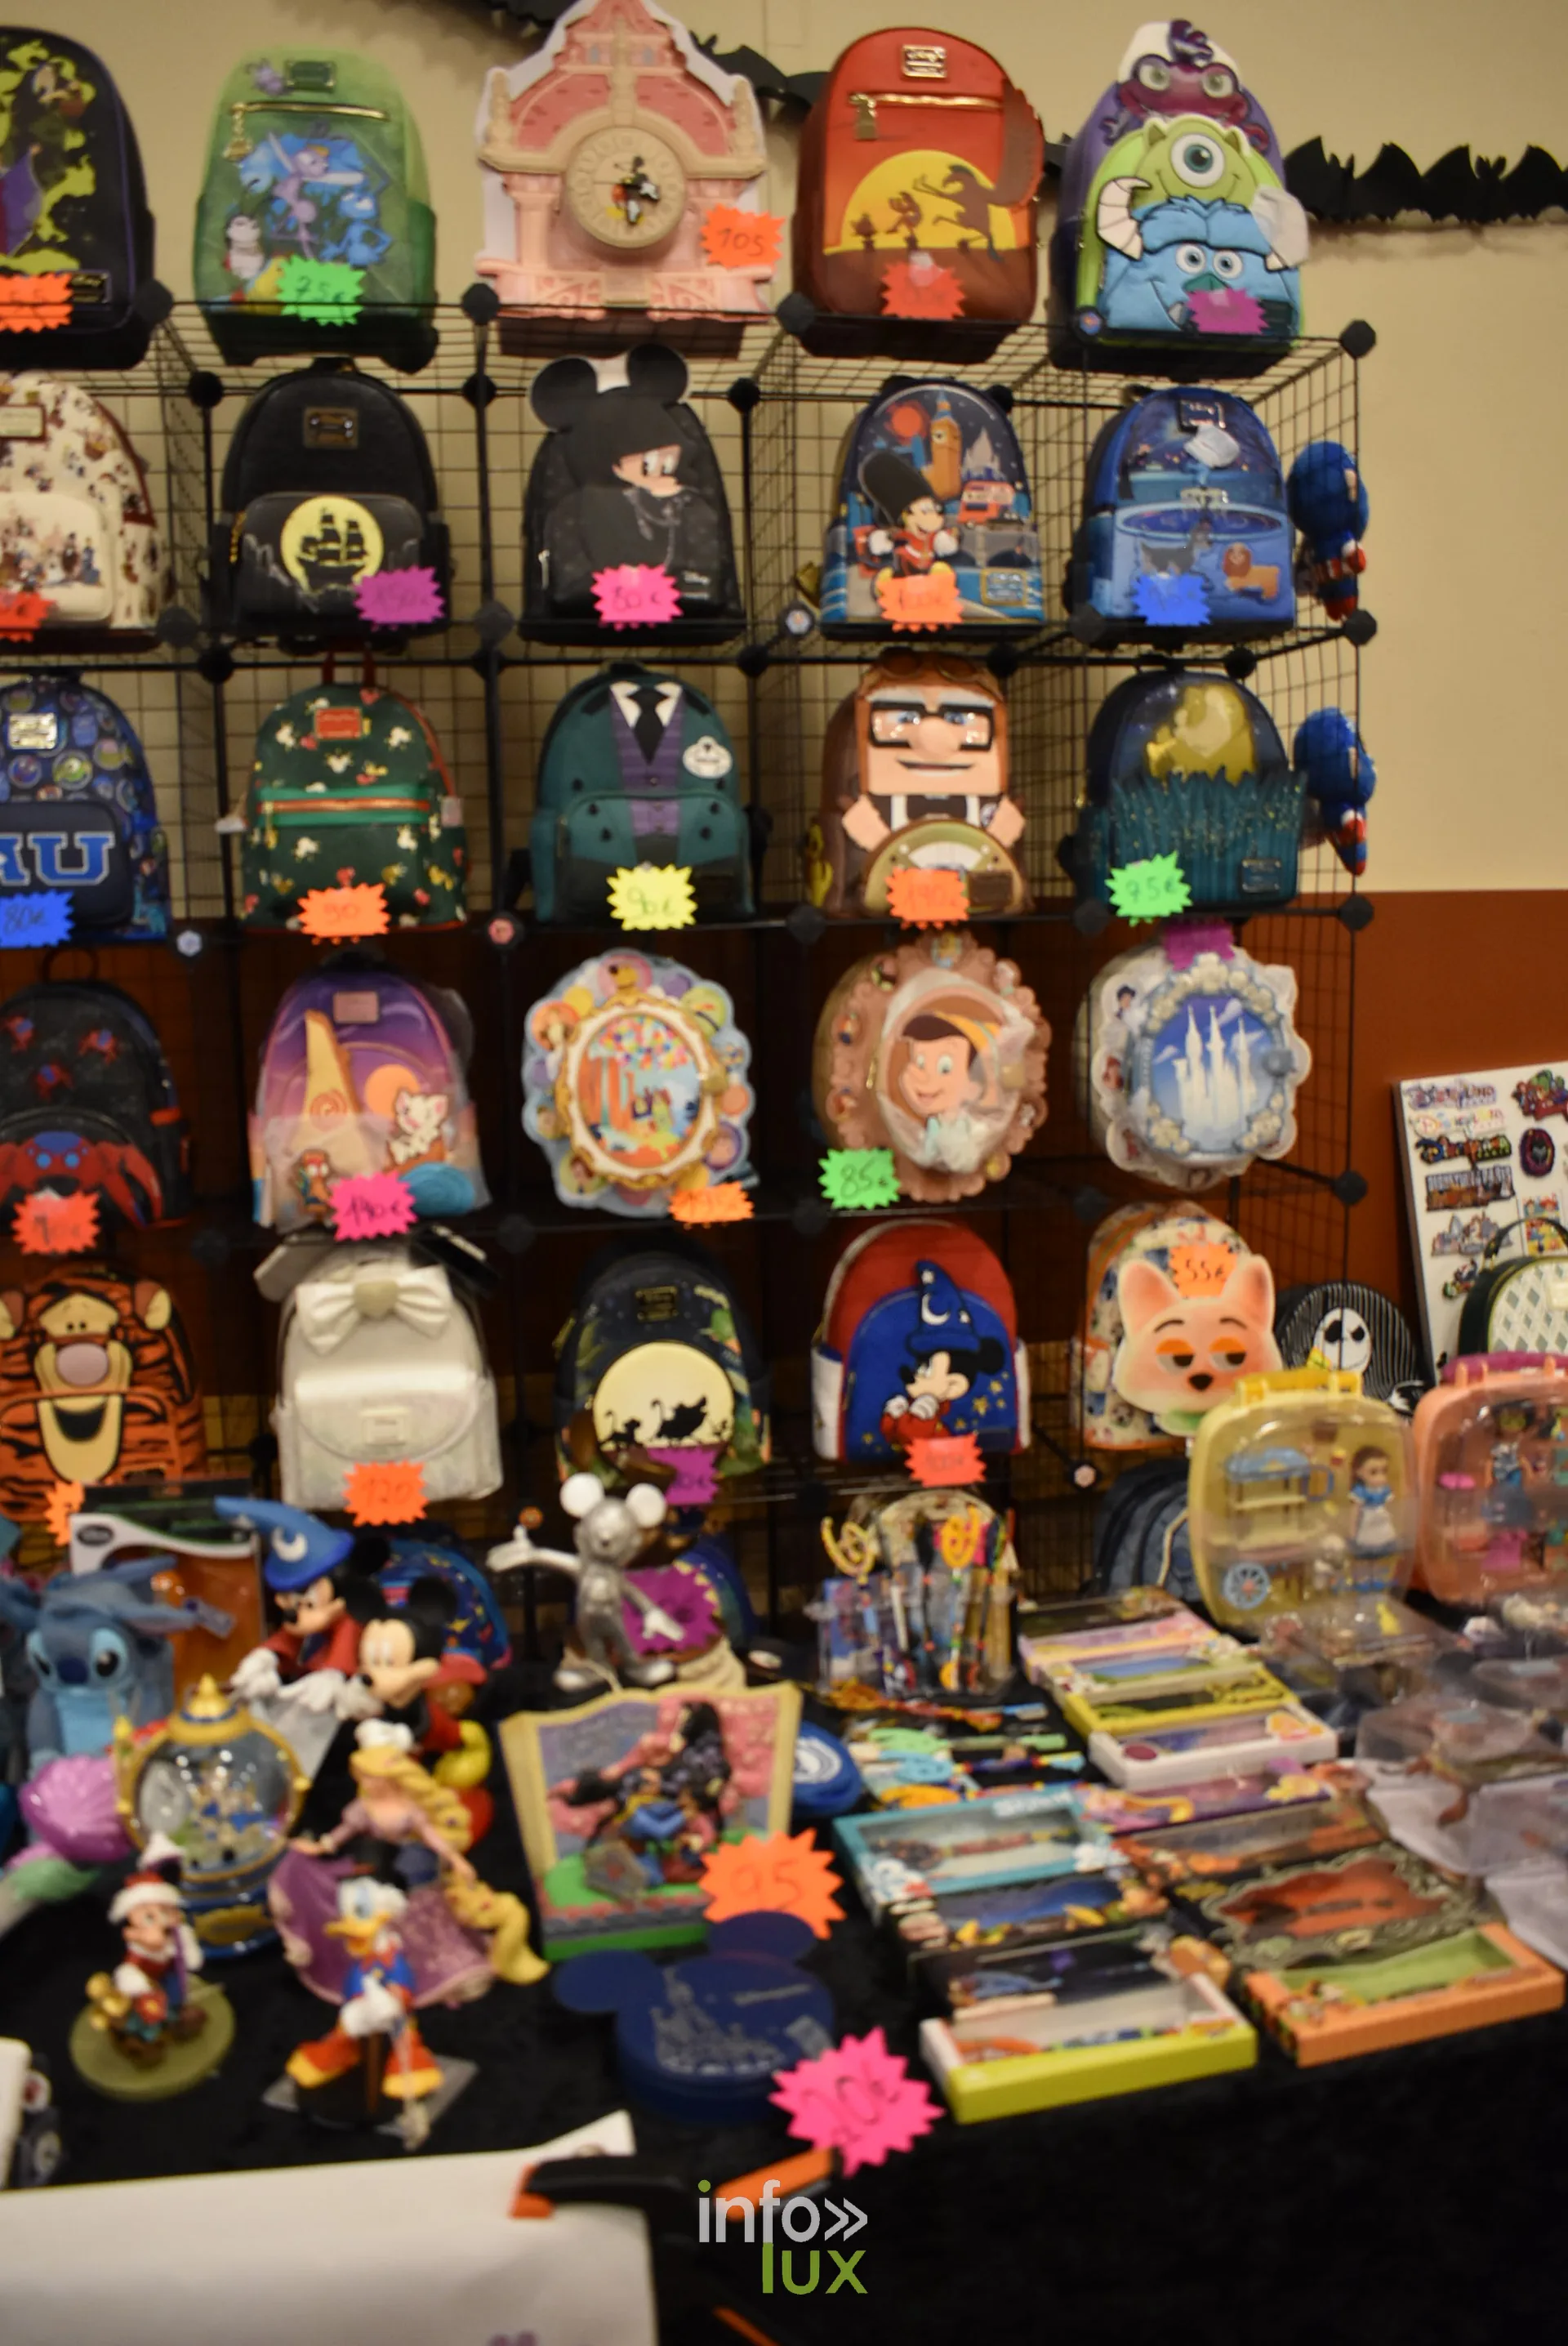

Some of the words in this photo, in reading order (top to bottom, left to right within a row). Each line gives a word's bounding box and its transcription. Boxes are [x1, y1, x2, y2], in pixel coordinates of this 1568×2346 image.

[717, 225, 767, 258] 105
[840, 1155, 889, 1201] 85€
[362, 1477, 414, 1508] 120
[730, 1858, 803, 1911] 95
